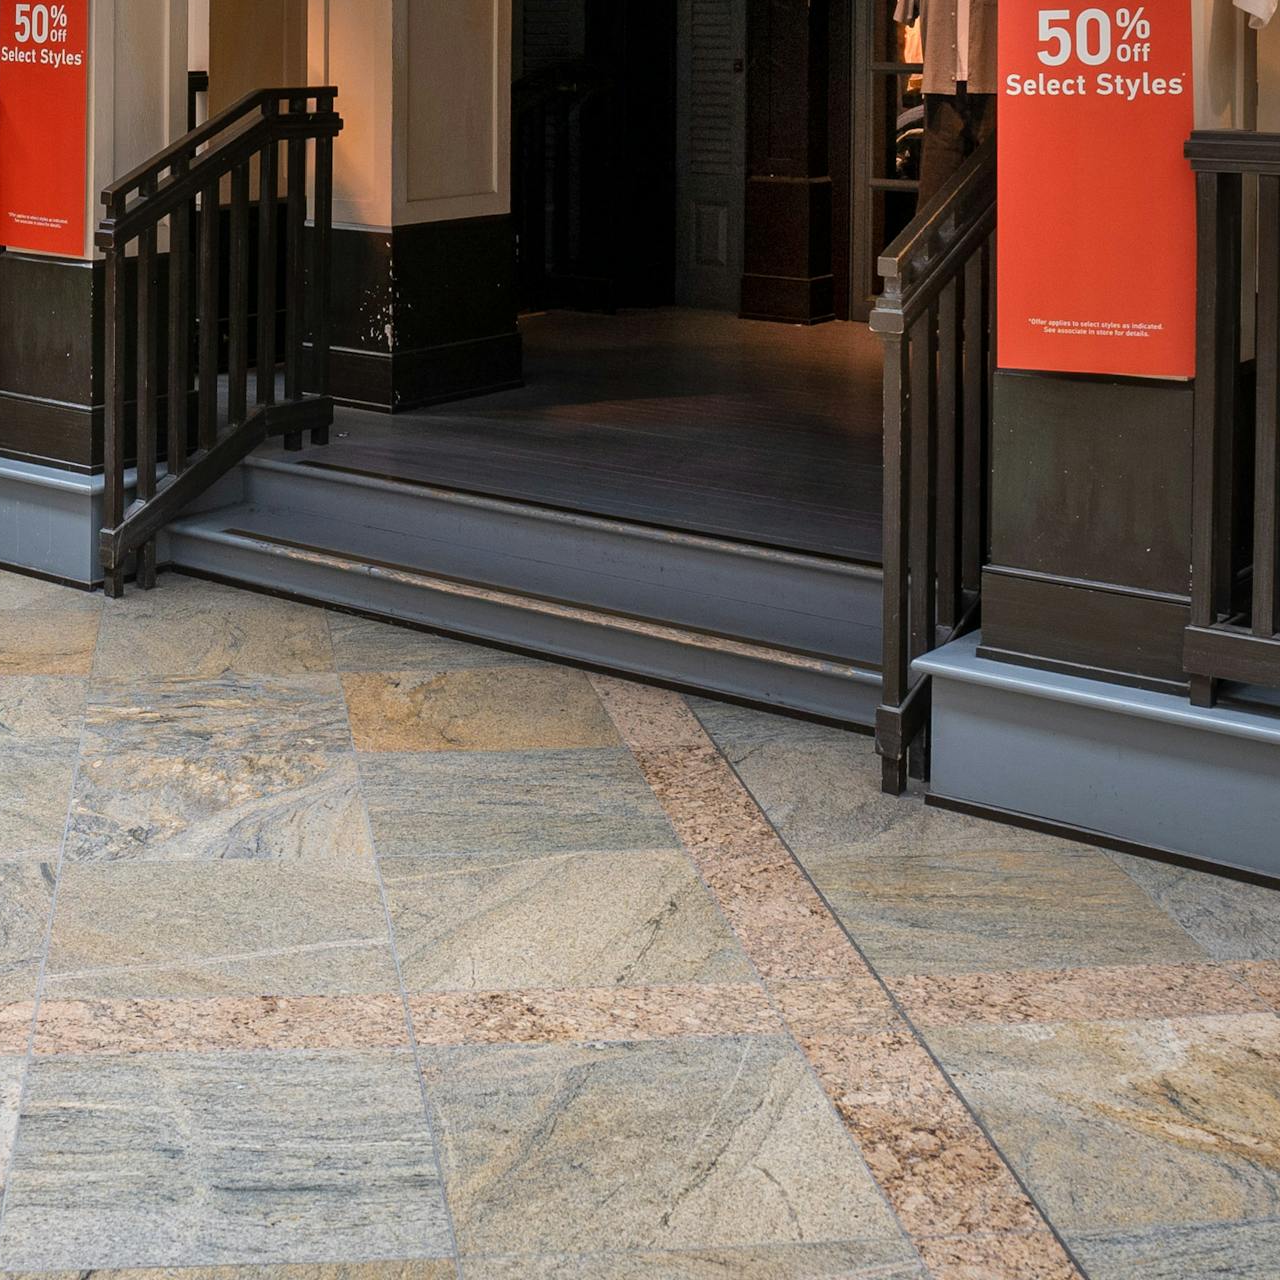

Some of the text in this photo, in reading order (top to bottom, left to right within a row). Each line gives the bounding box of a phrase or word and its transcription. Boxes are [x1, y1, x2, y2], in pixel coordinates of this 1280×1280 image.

[15, 3, 67, 43] 50%
[50, 29, 67, 42] Off
[1037, 7, 1150, 66] 50%
[1, 46, 36, 63] Select
[1116, 43, 1150, 62] Off
[1006, 73, 1086, 96] Select
